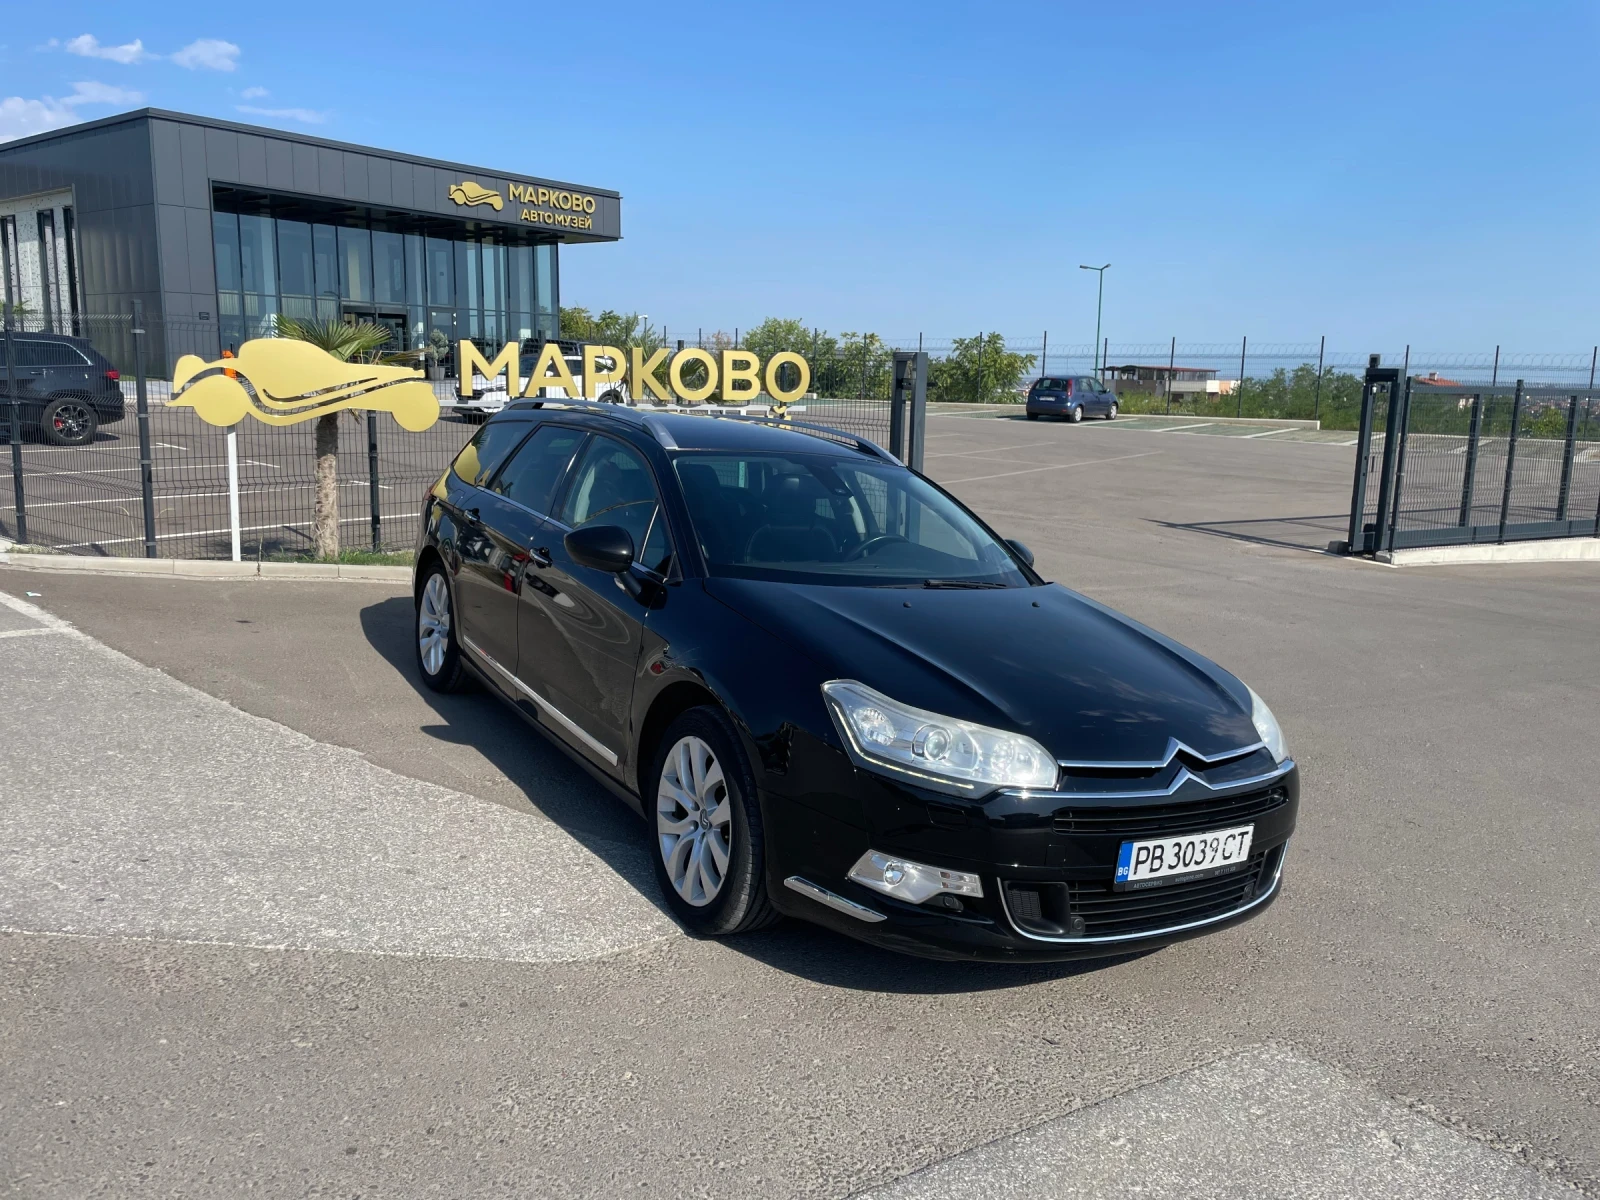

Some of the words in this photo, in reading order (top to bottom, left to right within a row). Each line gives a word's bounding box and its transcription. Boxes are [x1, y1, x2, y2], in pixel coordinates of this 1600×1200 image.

[508, 183, 596, 214] МАРКОВО
[520, 208, 553, 225] АВТО
[555, 213, 593, 230] МУЗЕЙ
[458, 339, 811, 402] МАРКОВО
[1117, 866, 1129, 876] BG
